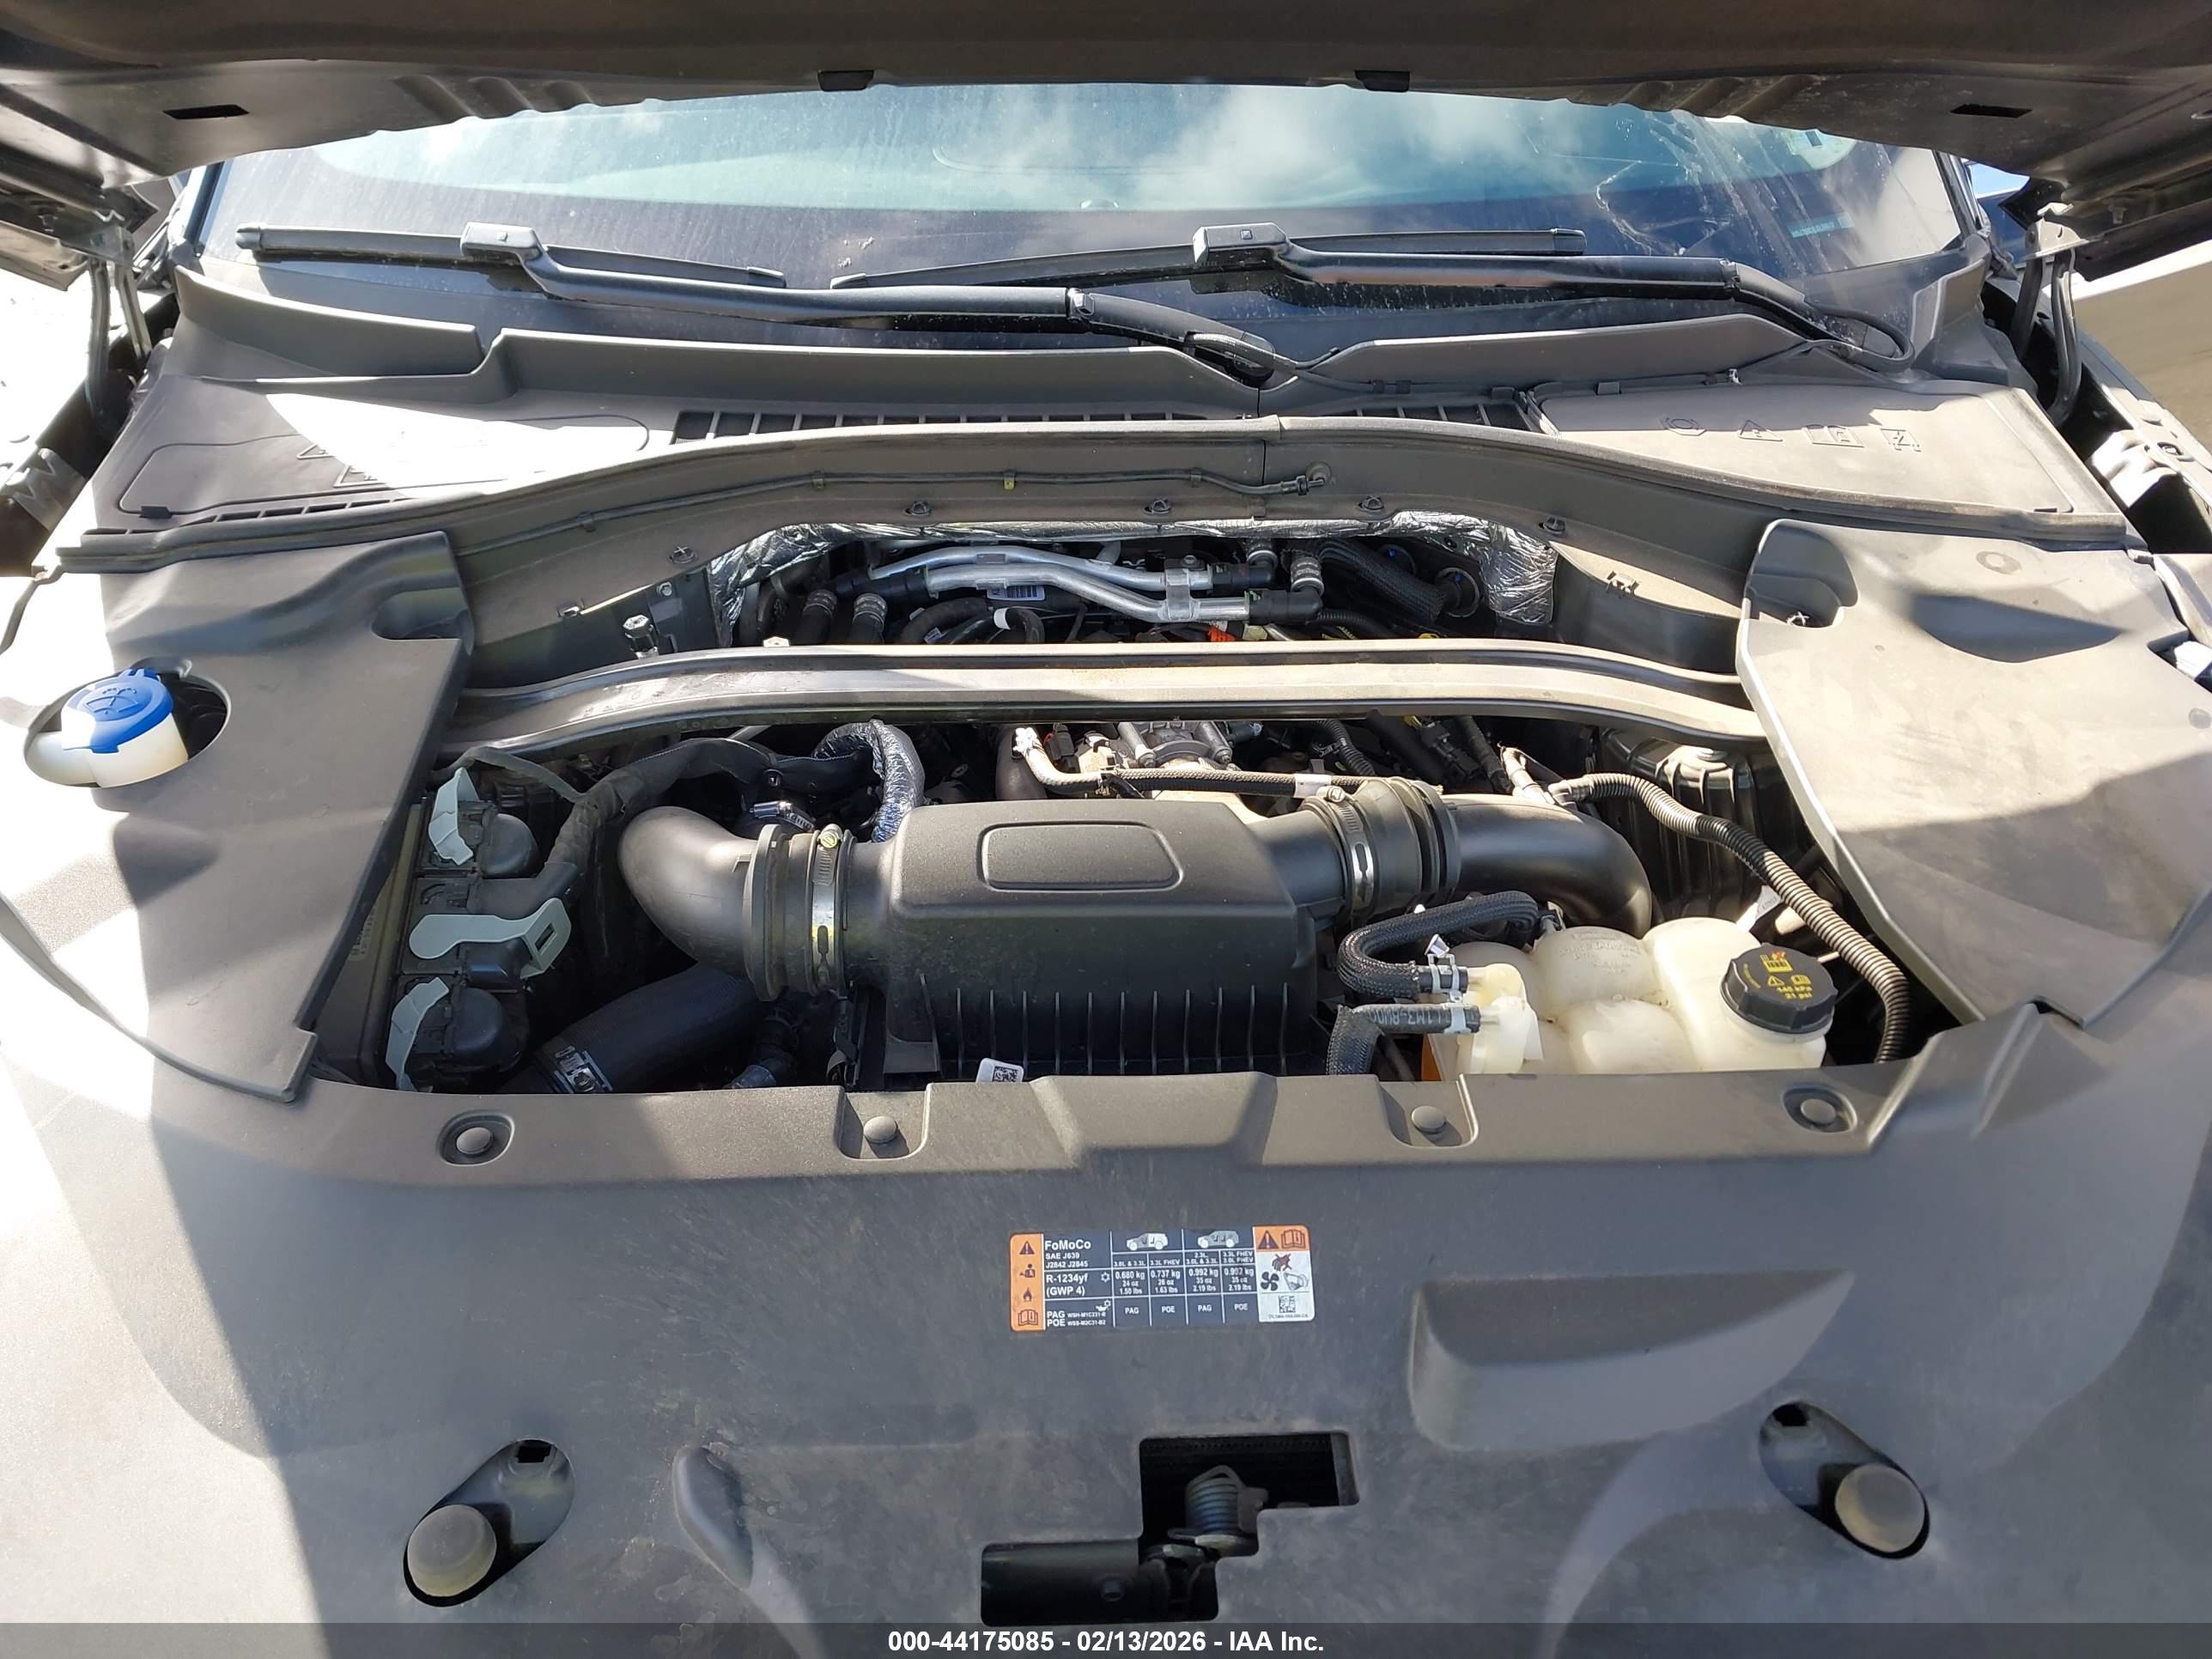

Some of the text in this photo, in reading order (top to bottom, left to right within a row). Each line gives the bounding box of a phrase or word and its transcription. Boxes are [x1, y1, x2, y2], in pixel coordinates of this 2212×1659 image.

[1044, 1239, 1091, 1250] FoMoCo
[1115, 1271, 1146, 1280] 0.680 kg
[1151, 1269, 1181, 1279] 0.737 kg
[1188, 1267, 1218, 1278] 0.992 kg
[1245, 1267, 1254, 1277] kg
[1046, 1273, 1089, 1285] R-1234yf
[1046, 1285, 1085, 1298] (GWP 4)
[1048, 1310, 1066, 1319] PAG
